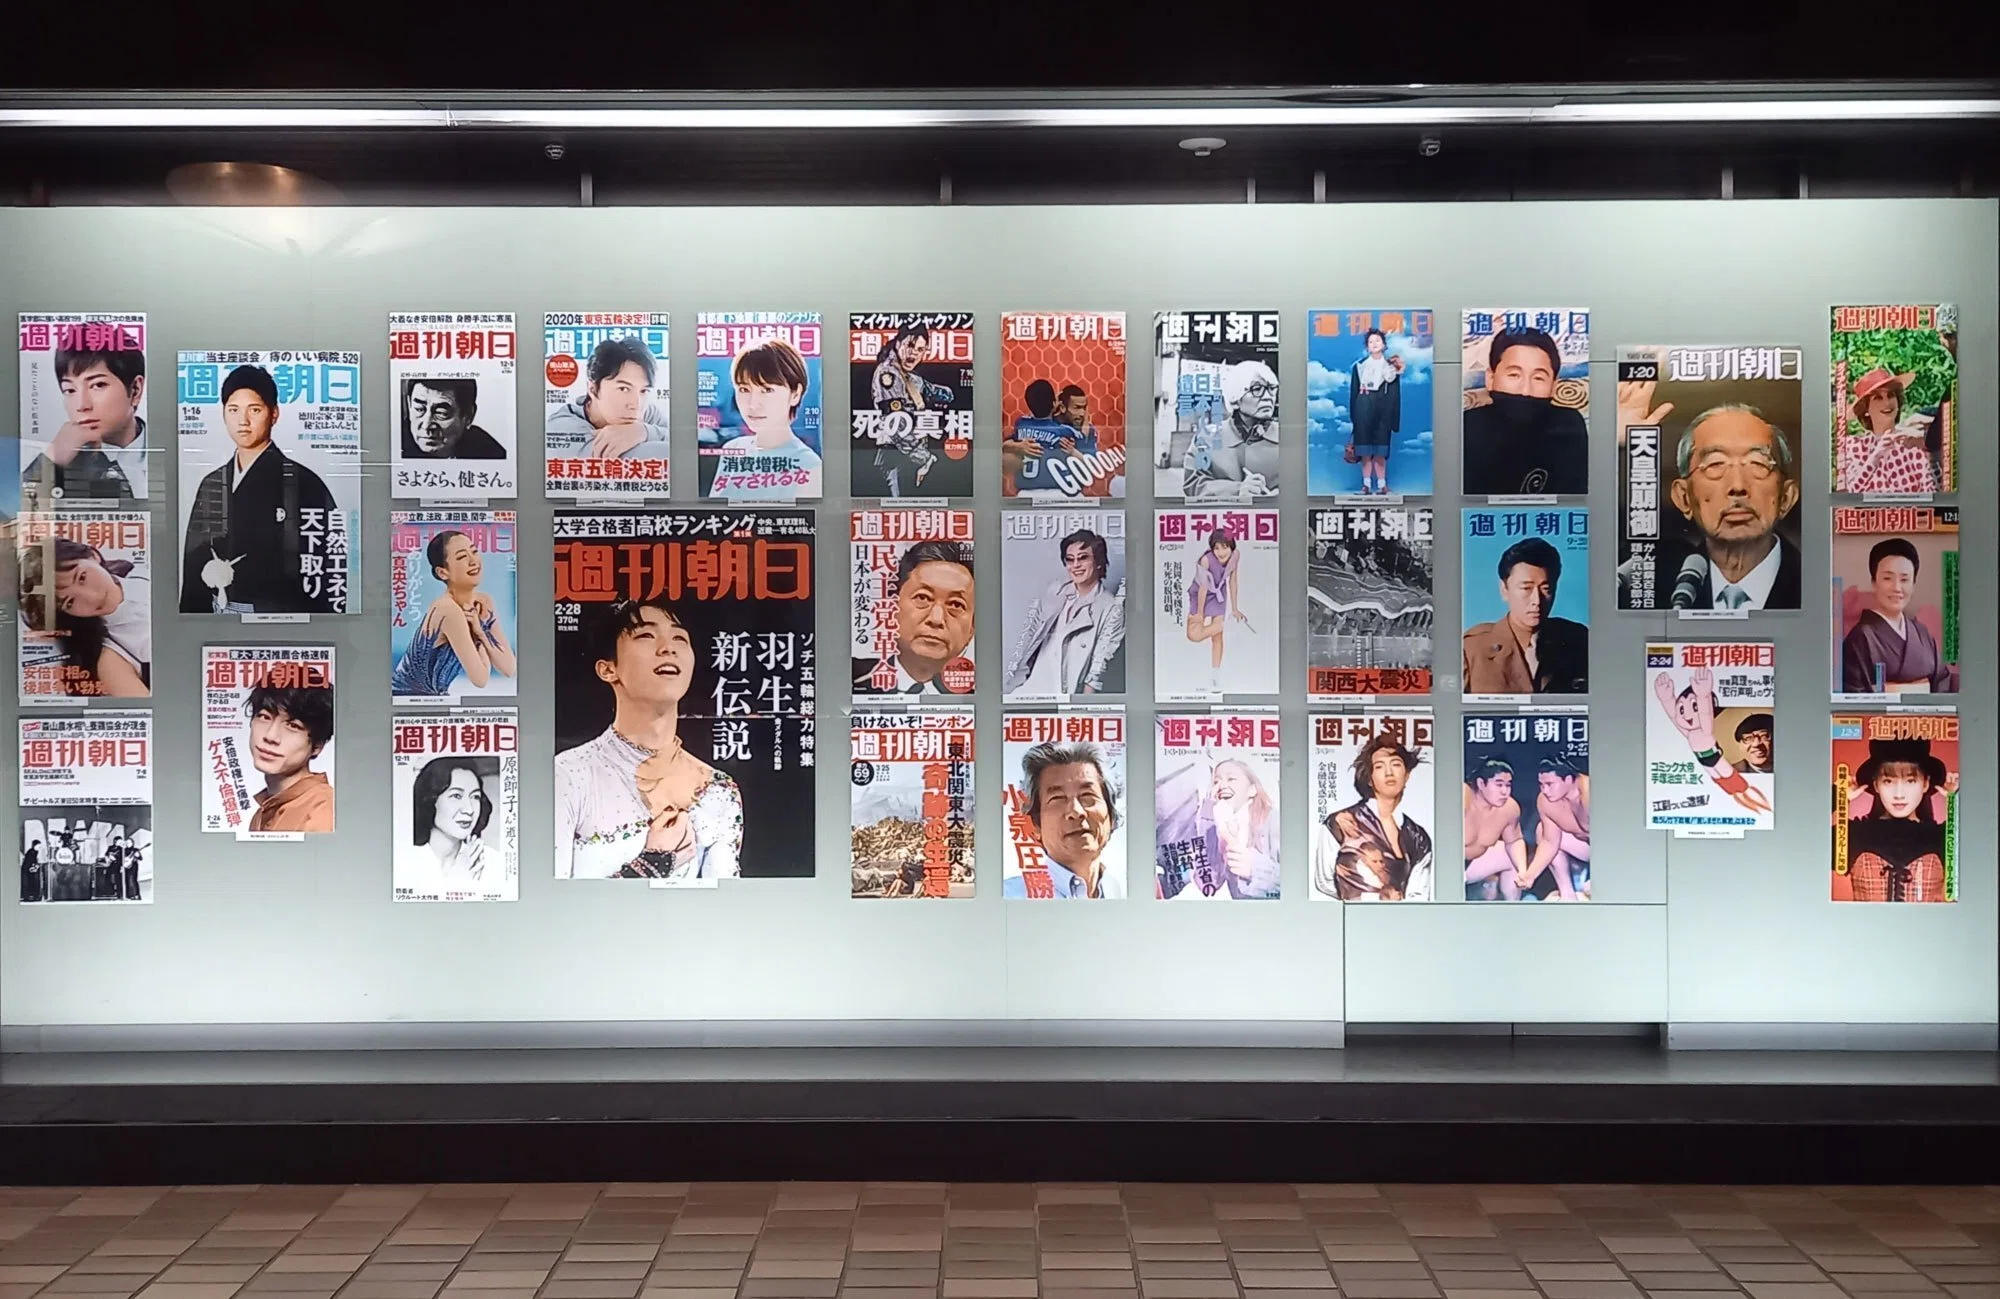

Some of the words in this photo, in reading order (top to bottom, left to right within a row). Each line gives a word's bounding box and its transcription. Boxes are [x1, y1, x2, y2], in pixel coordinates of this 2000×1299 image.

[390, 315, 452, 323] 大義なき安倍解散
[851, 313, 973, 329] マイケル・ジャクソン
[1007, 316, 1126, 341] 週刊朝日
[1162, 312, 1279, 343] 週刊朝日
[1469, 312, 1589, 336] 週刊朝日
[1834, 306, 1938, 331] 週刊朝日
[20, 324, 144, 351] 週刊朝日
[390, 331, 515, 359] 週刊朝日
[851, 331, 973, 362] 週朝日
[1669, 348, 1802, 381] 週刊朝日
[178, 364, 358, 404] 週朝日
[852, 410, 973, 440] 死の真相
[397, 470, 512, 488] さよなら、健さん。
[547, 459, 668, 479] 東京五輪決定!
[723, 457, 800, 472] 消費増税に
[1047, 445, 1126, 495] GOOOAL
[714, 470, 811, 491] ダマされるな
[1630, 429, 1657, 536] 天皇崩御
[853, 511, 973, 541] 週刊朝日
[1007, 515, 1126, 540] 週刊朝日
[1159, 512, 1278, 541] 週刊朝日
[1316, 510, 1432, 540] 週刊朝日
[1469, 512, 1588, 537] 週刊朝日
[1836, 508, 1935, 533] 週刊朝日
[300, 508, 325, 598] 天下取り
[326, 509, 348, 613] 自然エネで
[554, 539, 810, 601] 週刊朝日
[393, 556, 407, 627] 真央ちゃん
[854, 544, 871, 644] 日本が変わる
[557, 616, 579, 624] 370円
[871, 544, 899, 691] 民主党革命
[1681, 645, 1774, 668] 週刊朝日
[23, 666, 91, 680] 安倍首相の
[206, 661, 330, 688] 週刊朝日
[756, 632, 796, 714] 羽生
[1316, 669, 1422, 694] 関西大震災
[710, 630, 752, 761] 新伝説
[799, 633, 815, 767] ソチ五輪総力特集
[394, 725, 517, 753] 週刊朝日
[1004, 717, 1122, 742] 週刊朝日
[1164, 717, 1279, 747] 週刊朝日
[1315, 716, 1433, 746] 週刊朝日
[1467, 718, 1588, 742] 週刊朝日
[1868, 717, 1959, 742] 週刊朝日
[22, 740, 147, 767] 週刊朝日
[851, 731, 971, 760] 週刊朝日
[222, 736, 251, 811] 安倍政権に痛撃
[854, 768, 869, 778] 69
[1651, 762, 1695, 773] コミック大帝
[208, 739, 242, 828] ゲス不倫爆弾
[947, 742, 964, 866] 東北関東大震災
[923, 763, 949, 897] 奇跡の生還
[1002, 784, 1054, 899] 小泉圧勝
[1191, 836, 1216, 897] 厚生省の
